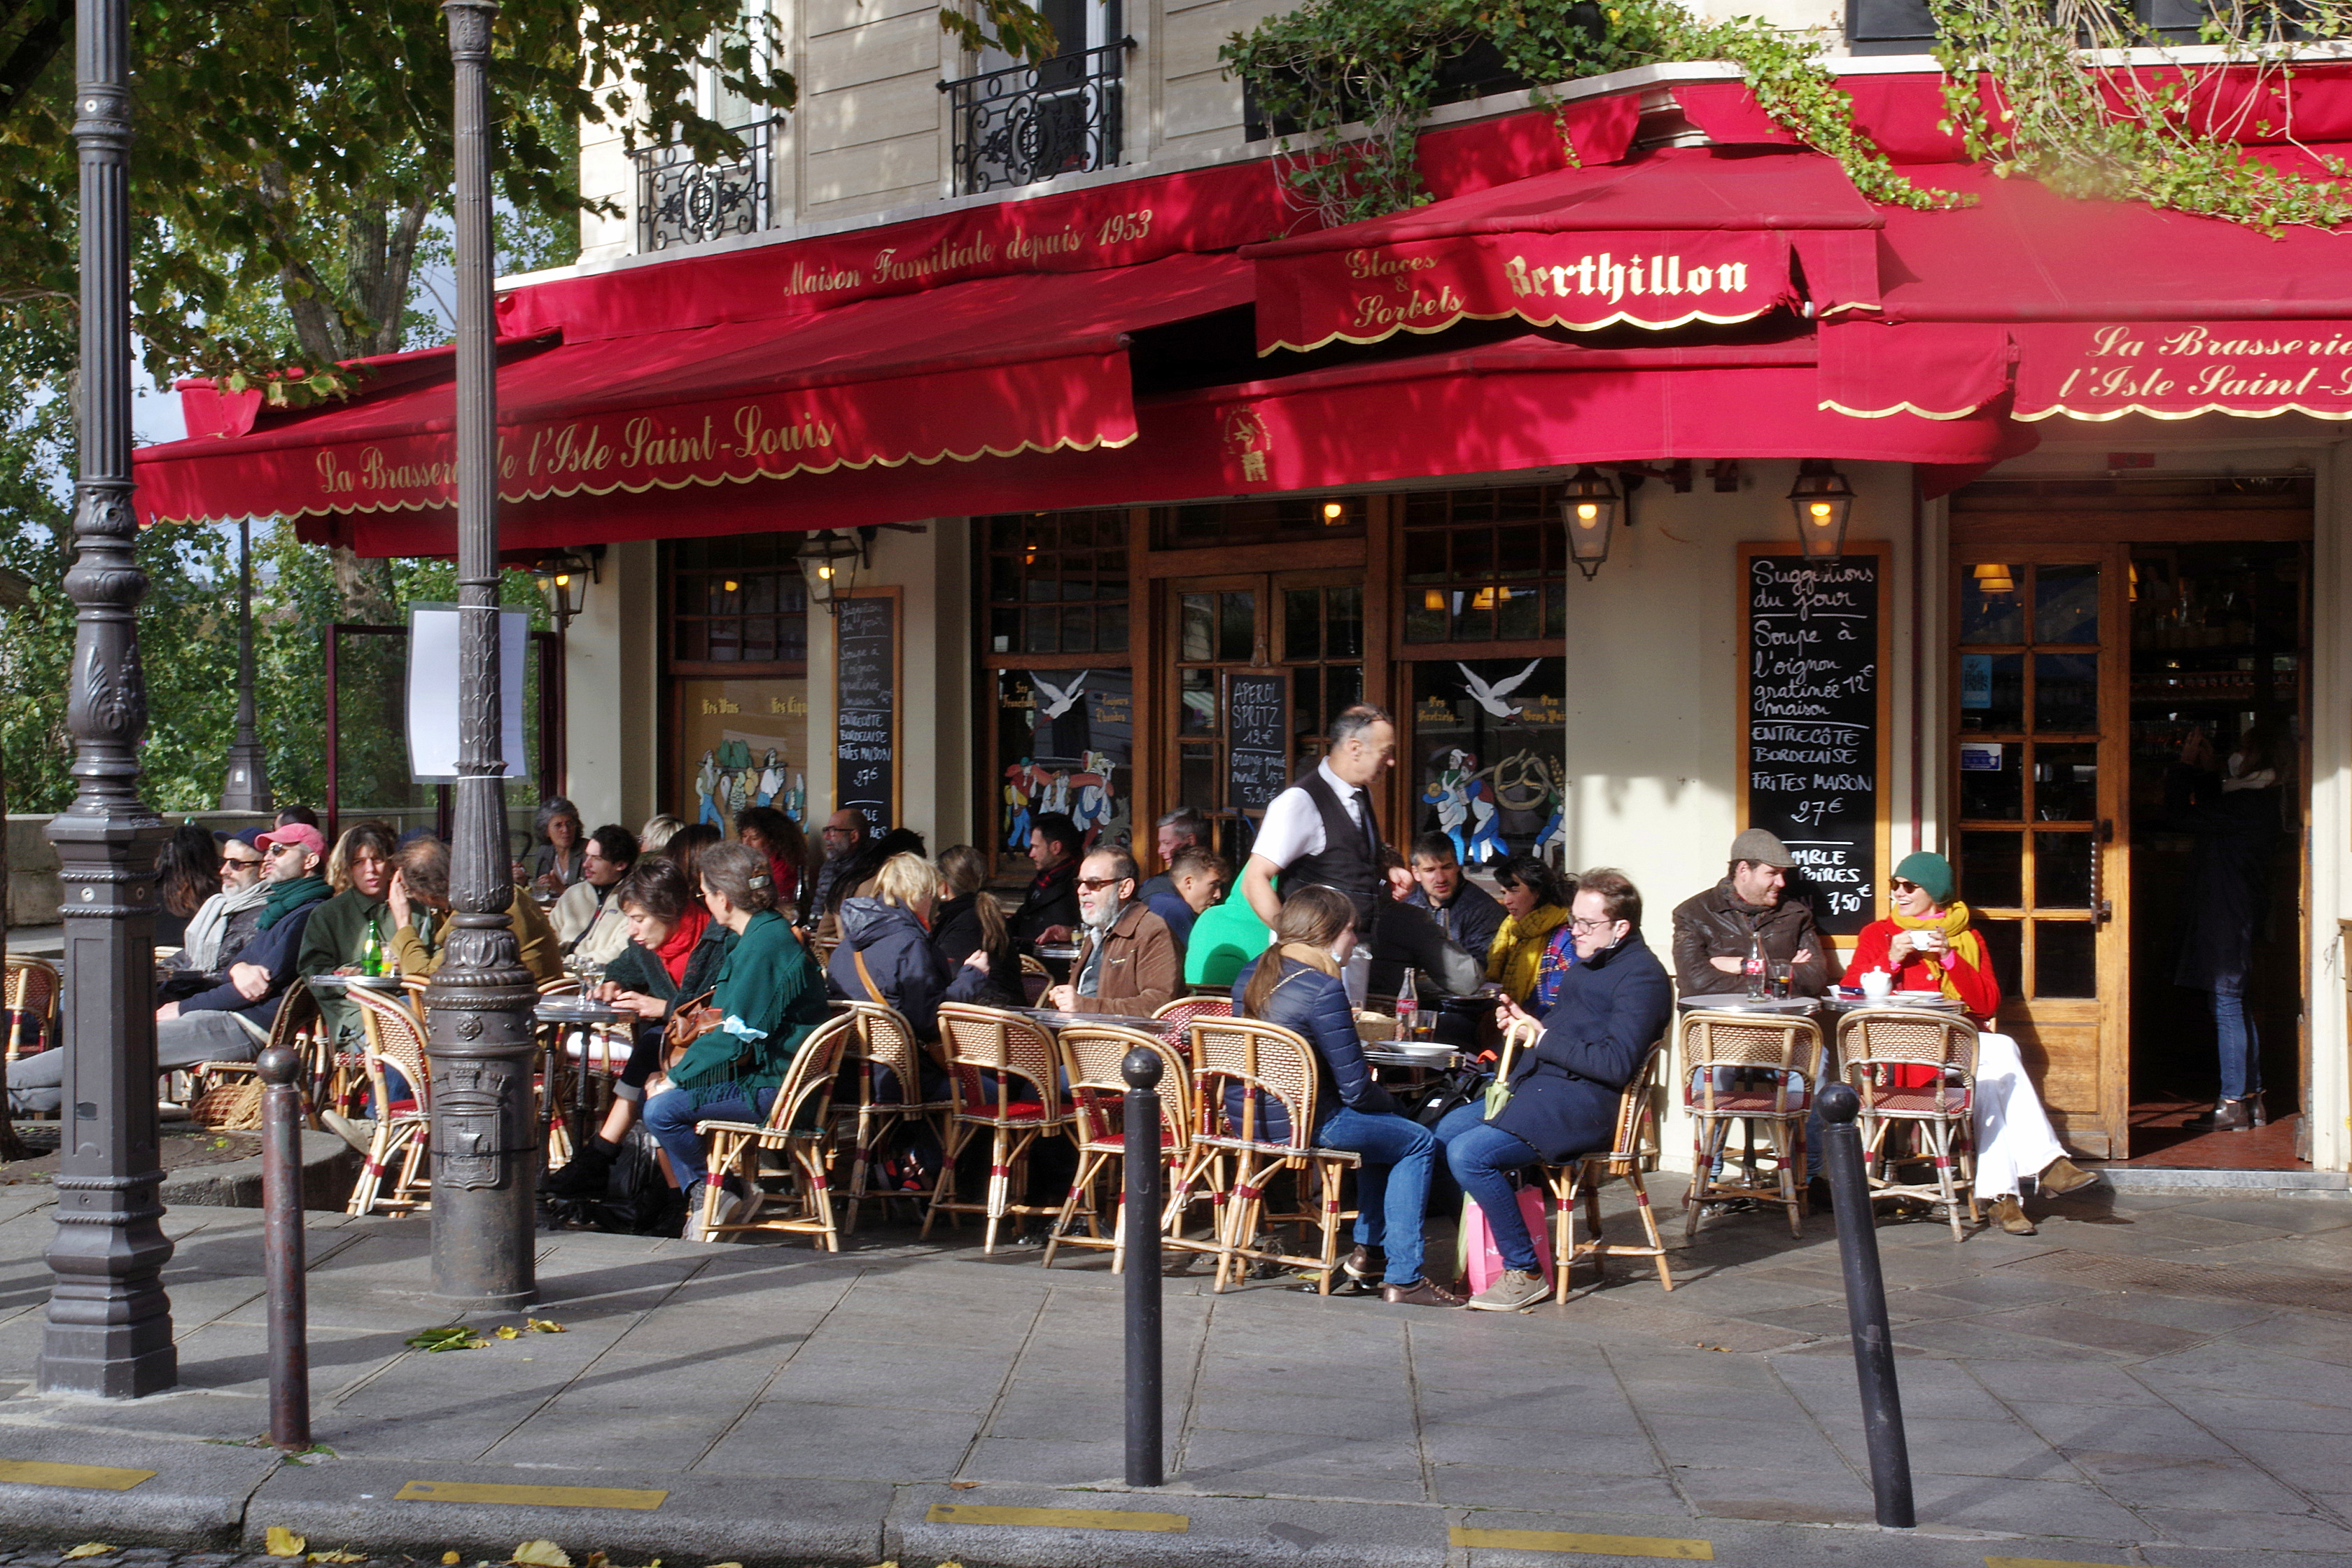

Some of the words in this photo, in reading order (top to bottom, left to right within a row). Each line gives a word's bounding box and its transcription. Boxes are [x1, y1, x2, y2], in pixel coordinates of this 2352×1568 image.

[783, 261, 862, 297] Maison
[872, 231, 994, 284] Familiale
[1005, 224, 1086, 267] depuis
[1096, 209, 1154, 246] 1953
[1345, 250, 1440, 279] Glaces
[1395, 275, 1410, 293] &
[1504, 253, 1749, 304] Berthillon
[1353, 286, 1466, 328] Sorbets
[2085, 326, 2144, 357] La
[2158, 325, 2352, 356] Brasserie
[2058, 365, 2176, 398] l'Isle
[317, 451, 355, 493] La
[359, 447, 460, 490] Brasseri
[528, 423, 615, 478] l'Isle
[620, 405, 837, 467] Saint-Louis
[1754, 588, 1784, 608] du
[1793, 591, 1857, 622] jour
[1754, 620, 1822, 658] Soupe
[1837, 622, 1858, 640] à
[1754, 650, 1842, 685] l'oignon
[1233, 682, 1280, 704] APEROL
[1754, 678, 1842, 712] gratinée
[1763, 701, 1831, 717] maison
[1791, 797, 1844, 826] 27€
[1788, 849, 1847, 865] MBLE
